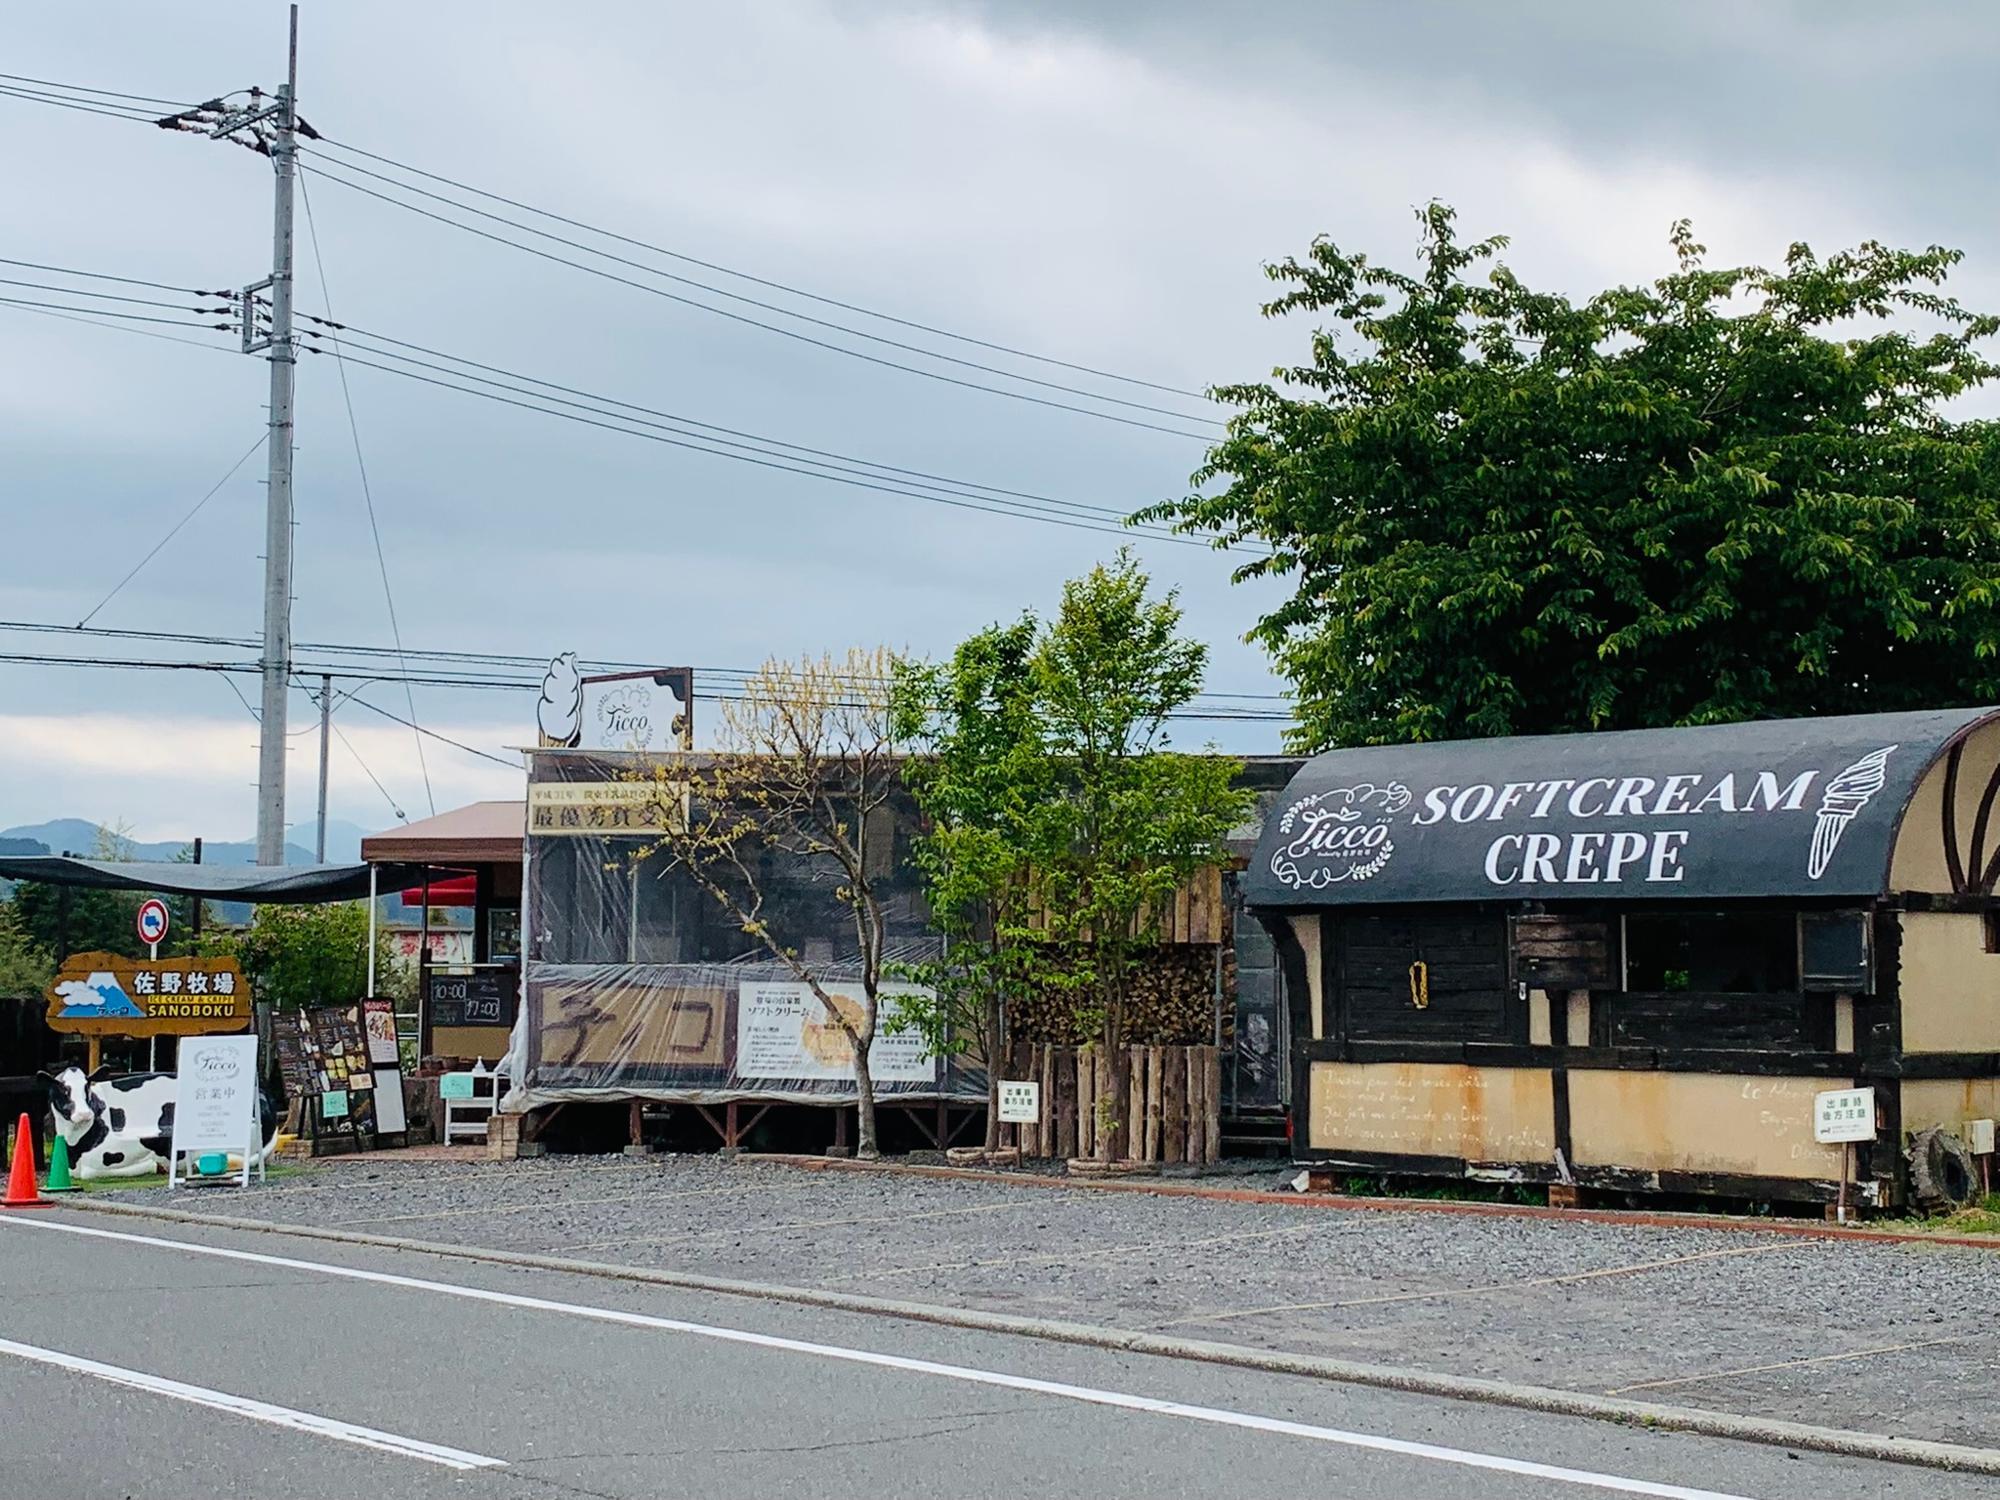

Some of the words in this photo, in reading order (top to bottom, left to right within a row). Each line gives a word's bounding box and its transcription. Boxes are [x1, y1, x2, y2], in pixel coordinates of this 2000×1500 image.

[607, 707, 648, 731] Ticco
[1411, 770, 1820, 825] SOFTCREAM
[535, 805, 684, 827] 最優秀賞受
[1288, 810, 1388, 858] Ticco
[1485, 830, 1689, 885] CREPE
[134, 971, 235, 994] 佐野牧場
[434, 983, 465, 999] 10:00
[148, 1005, 234, 1017] SANOBOKU
[467, 1000, 498, 1017] 17:00
[748, 1006, 810, 1017] ソフトクリーム
[200, 1057, 237, 1070] Ticco
[195, 1086, 236, 1100] 営業中
